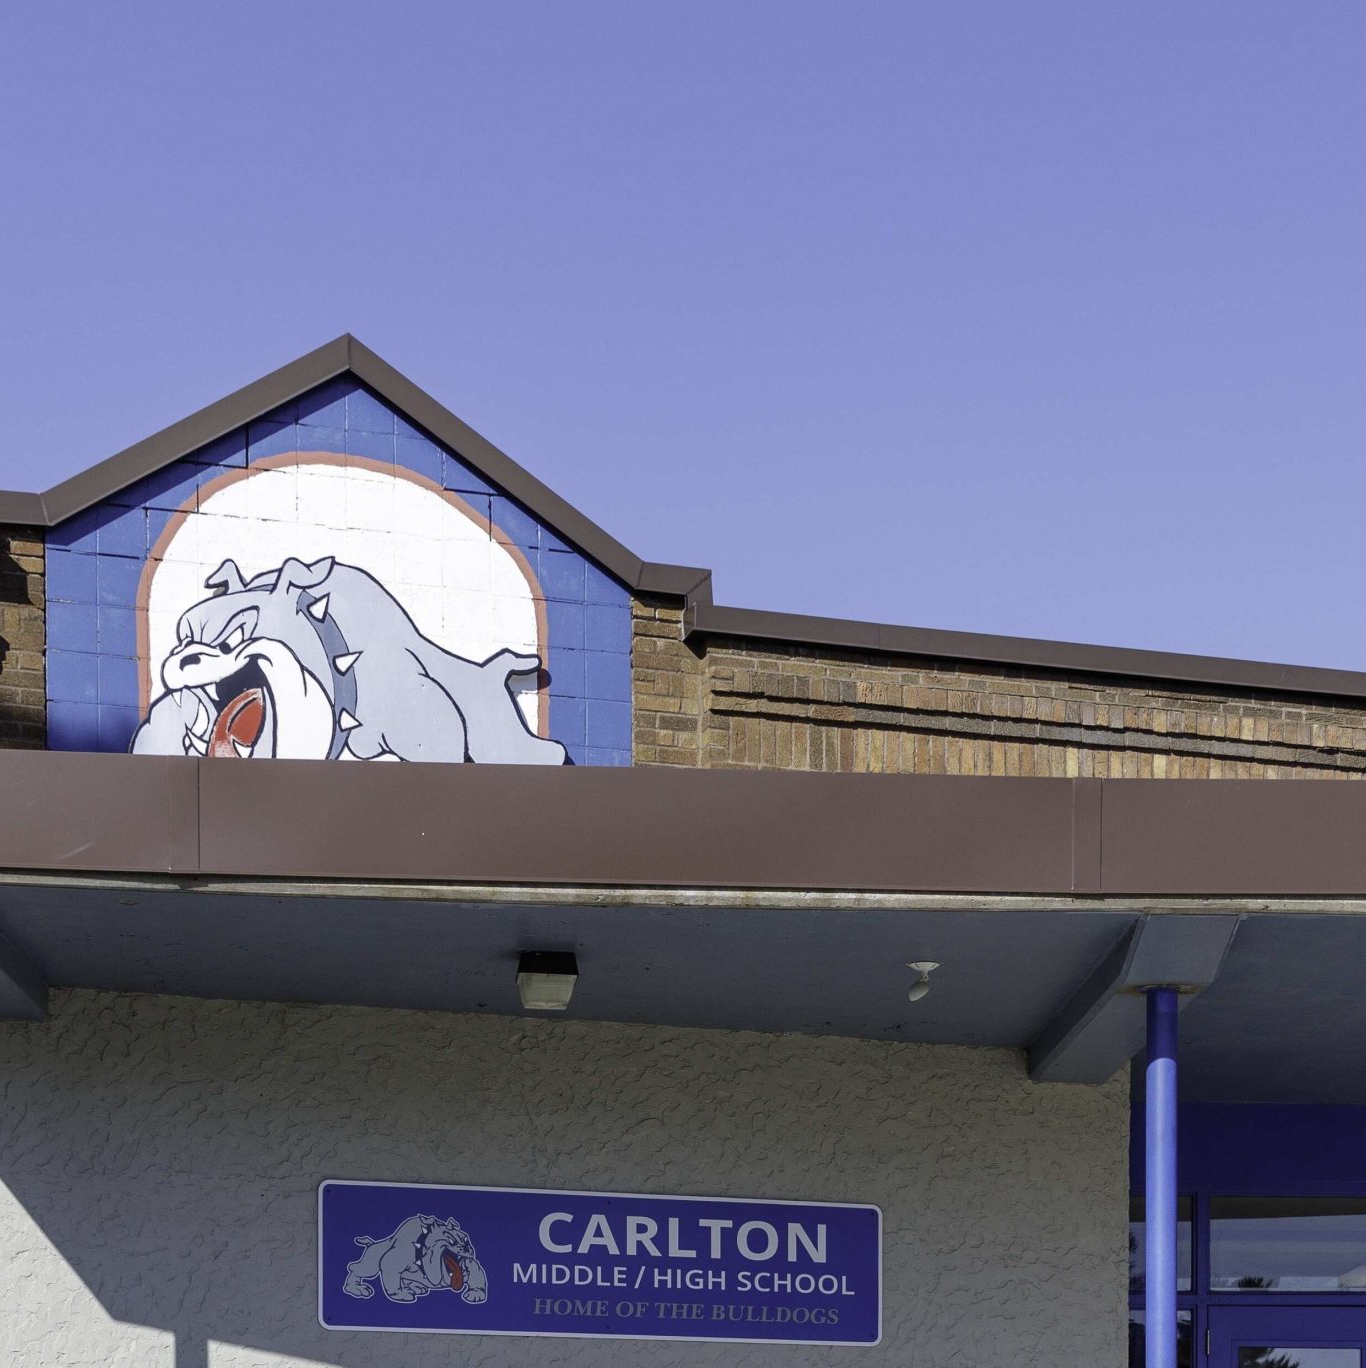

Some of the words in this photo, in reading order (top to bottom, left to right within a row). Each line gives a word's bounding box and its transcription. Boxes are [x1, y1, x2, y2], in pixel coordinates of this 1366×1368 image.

[538, 1212, 827, 1264] CARLTON
[737, 1271, 856, 1296] SCHOOL
[533, 1298, 610, 1317] HOME
[615, 1301, 649, 1318] OF
[654, 1302, 705, 1321] THE
[711, 1304, 840, 1325] BULLDOGS
